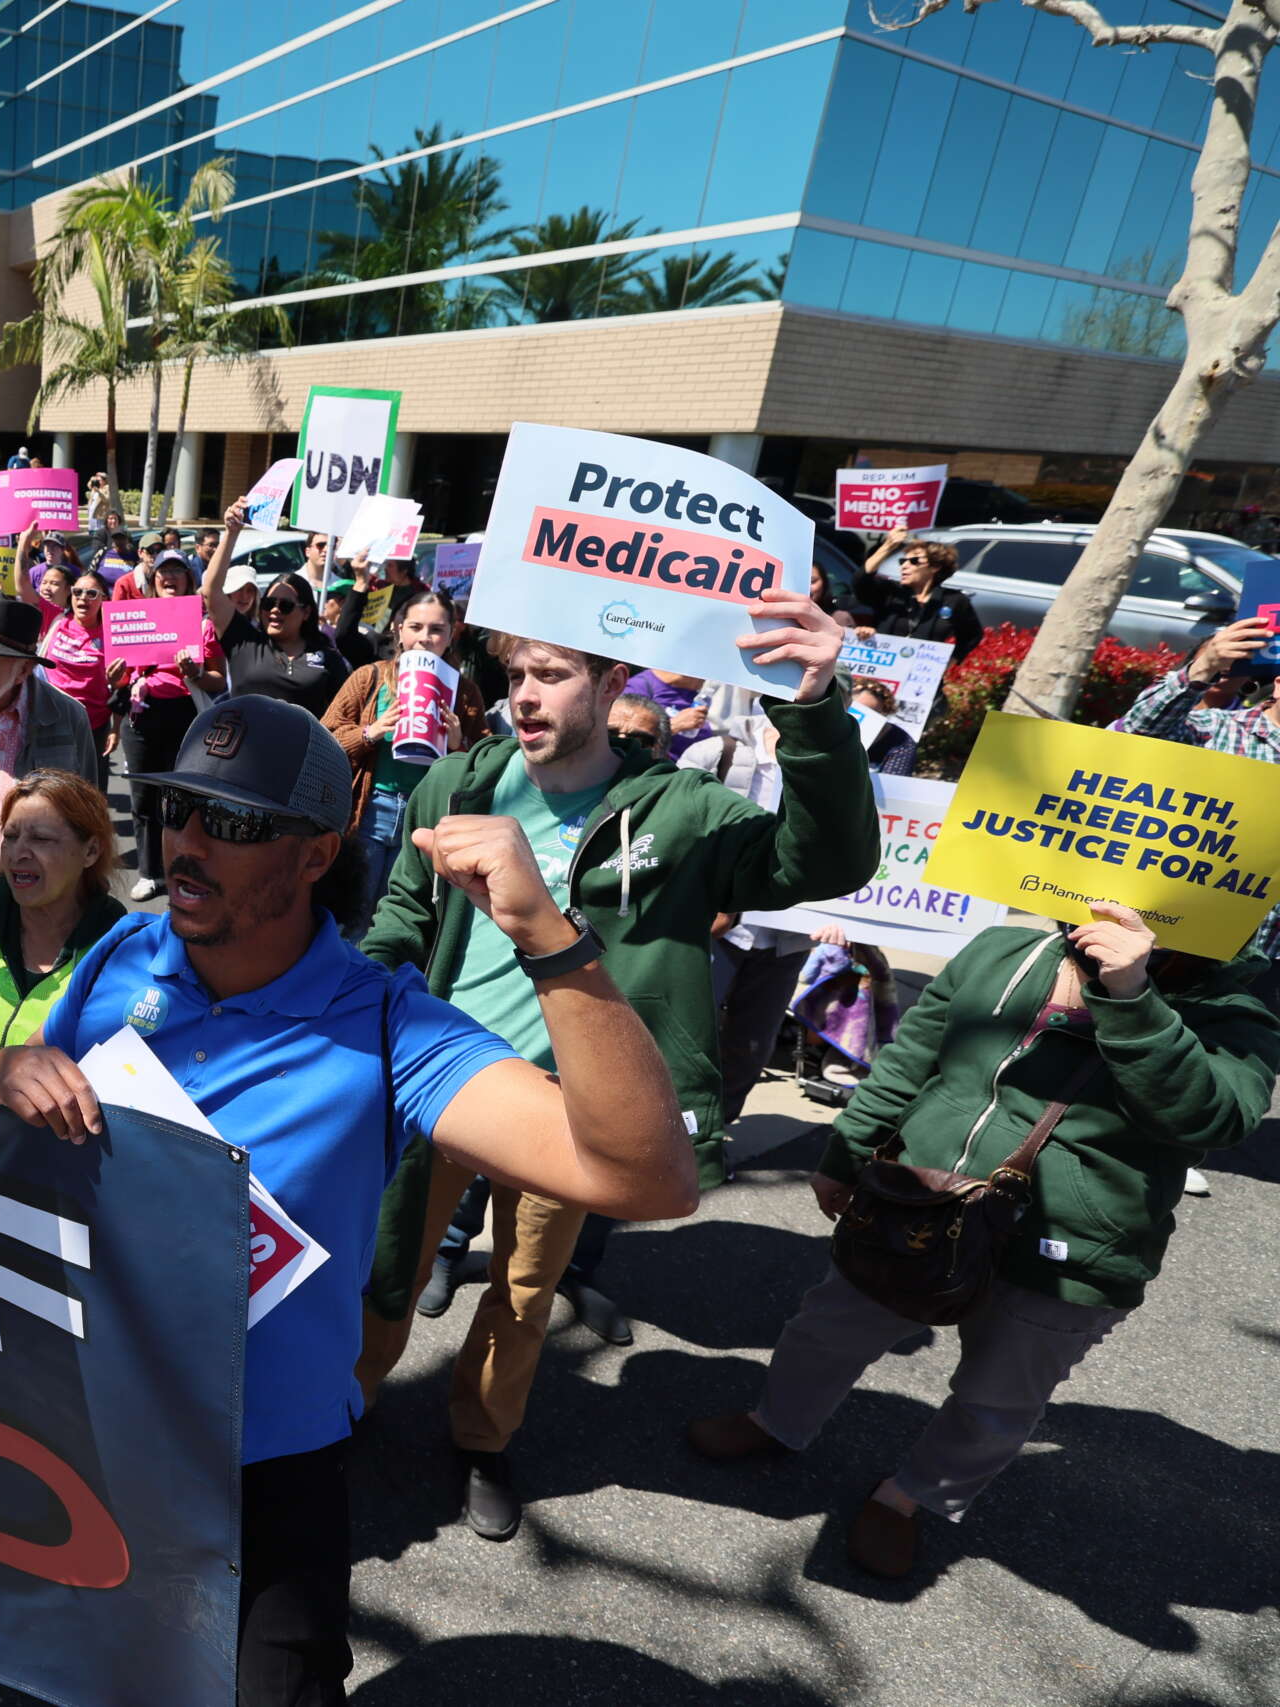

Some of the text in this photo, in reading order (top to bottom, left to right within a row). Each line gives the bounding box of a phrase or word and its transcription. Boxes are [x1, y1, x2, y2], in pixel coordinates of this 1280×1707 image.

[569, 462, 765, 542] Protect
[871, 487, 901, 501] NO
[843, 500, 931, 514] MEDI-CAL
[860, 515, 909, 528] CUTS
[532, 517, 777, 601] Medicaid
[2, 564, 9, 572] &
[127, 611, 147, 620] FOR
[605, 612, 666, 633] CareCantWait
[110, 622, 157, 633] PLANNED
[111, 633, 178, 645] PARENTHOOD
[842, 646, 894, 664] EALTH
[846, 662, 877, 675] VER
[1067, 769, 1241, 830] HEALTH,
[1034, 793, 1240, 864] FREEDOM,
[962, 809, 1273, 900] JUSTICE FOR ALL
[874, 864, 891, 881] &
[837, 884, 971, 923] DICARE!
[143, 989, 161, 1006] NO
[133, 1001, 161, 1022] CUTS
